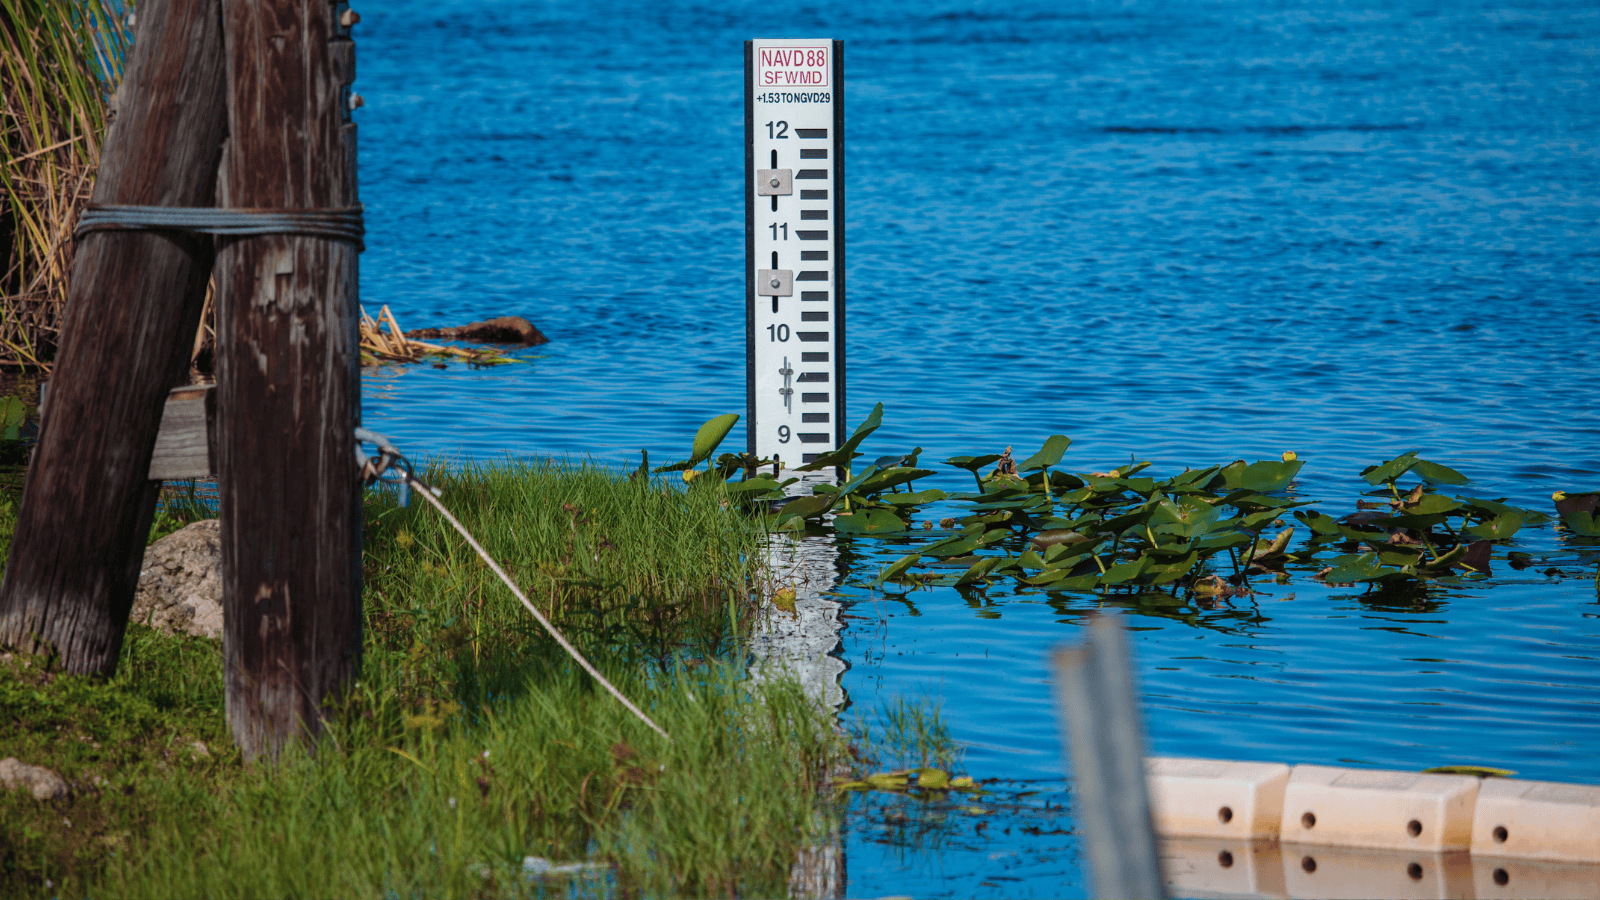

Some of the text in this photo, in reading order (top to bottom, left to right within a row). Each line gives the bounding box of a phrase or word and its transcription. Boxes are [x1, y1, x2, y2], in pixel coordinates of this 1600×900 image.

[764, 71, 823, 84] SFWMD
[765, 120, 789, 139] 12
[768, 222, 788, 241] 11
[766, 323, 790, 342] 10
[777, 424, 791, 444] 9
